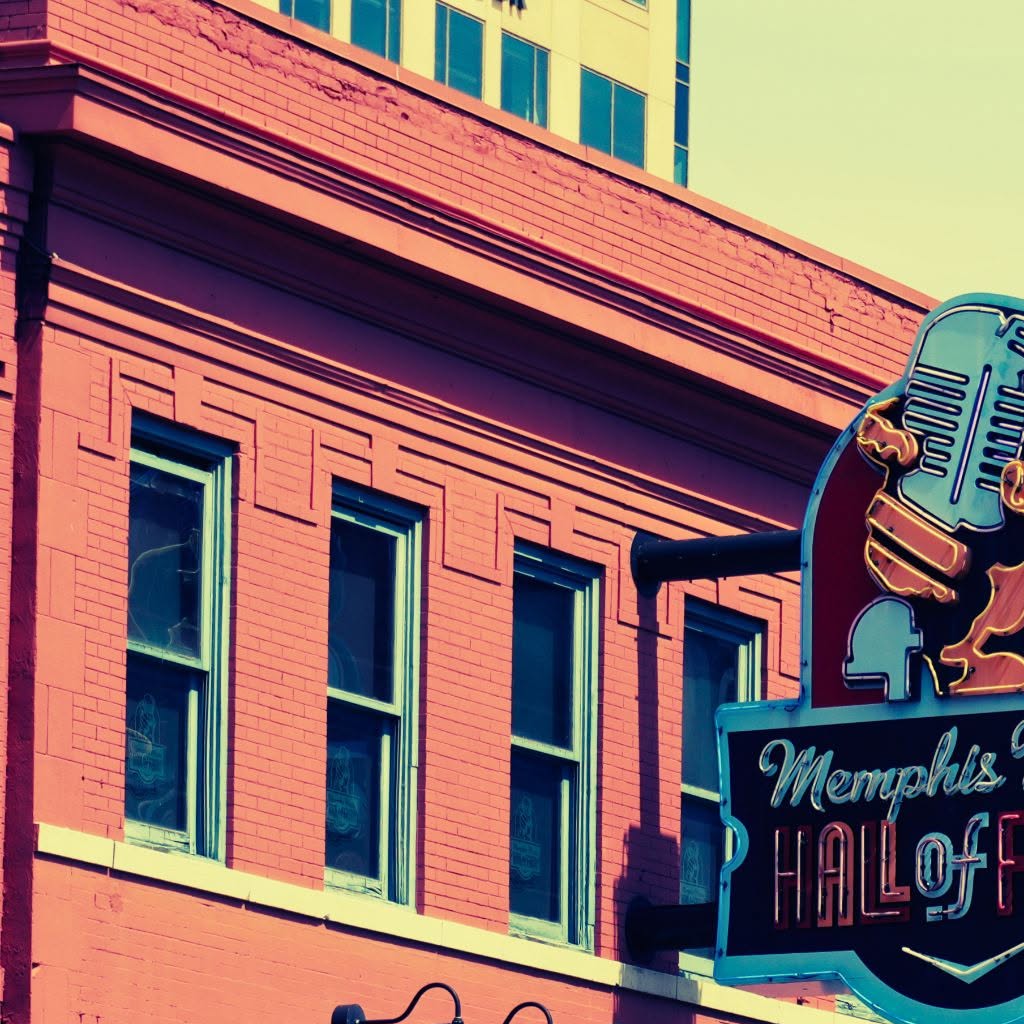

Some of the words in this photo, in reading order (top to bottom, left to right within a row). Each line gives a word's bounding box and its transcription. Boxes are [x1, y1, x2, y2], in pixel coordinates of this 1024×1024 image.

[759, 725, 1005, 822] Memphis
[773, 819, 910, 931] HALL
[914, 811, 990, 923] of
